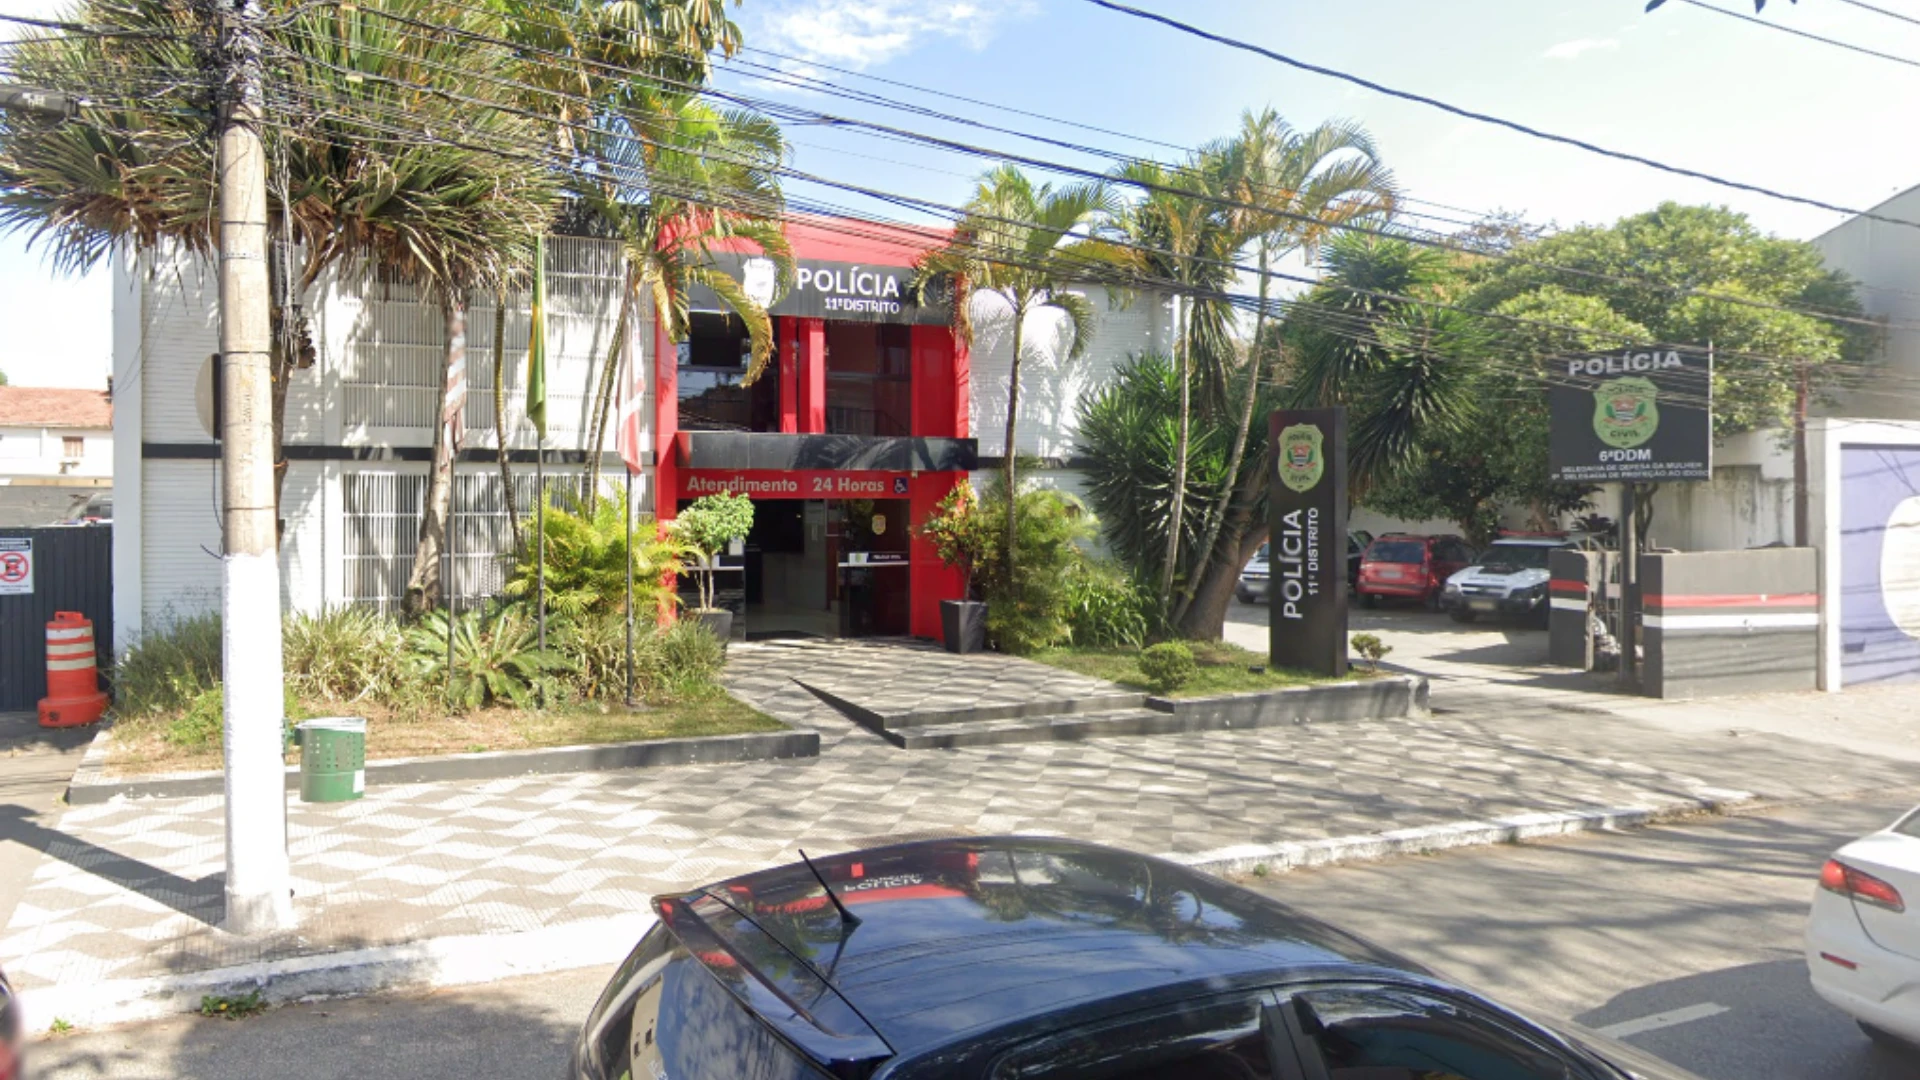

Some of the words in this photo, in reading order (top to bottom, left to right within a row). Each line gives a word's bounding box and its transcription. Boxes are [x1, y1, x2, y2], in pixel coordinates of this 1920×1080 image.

[796, 266, 900, 297] POLÍCIA
[1568, 350, 1683, 376] POLÍCIA
[687, 475, 798, 492] Atendimento
[813, 477, 833, 492] 24
[838, 476, 885, 492] Horas
[1308, 507, 1319, 571] DISTRITO
[1278, 509, 1304, 618] POLÍCIA
